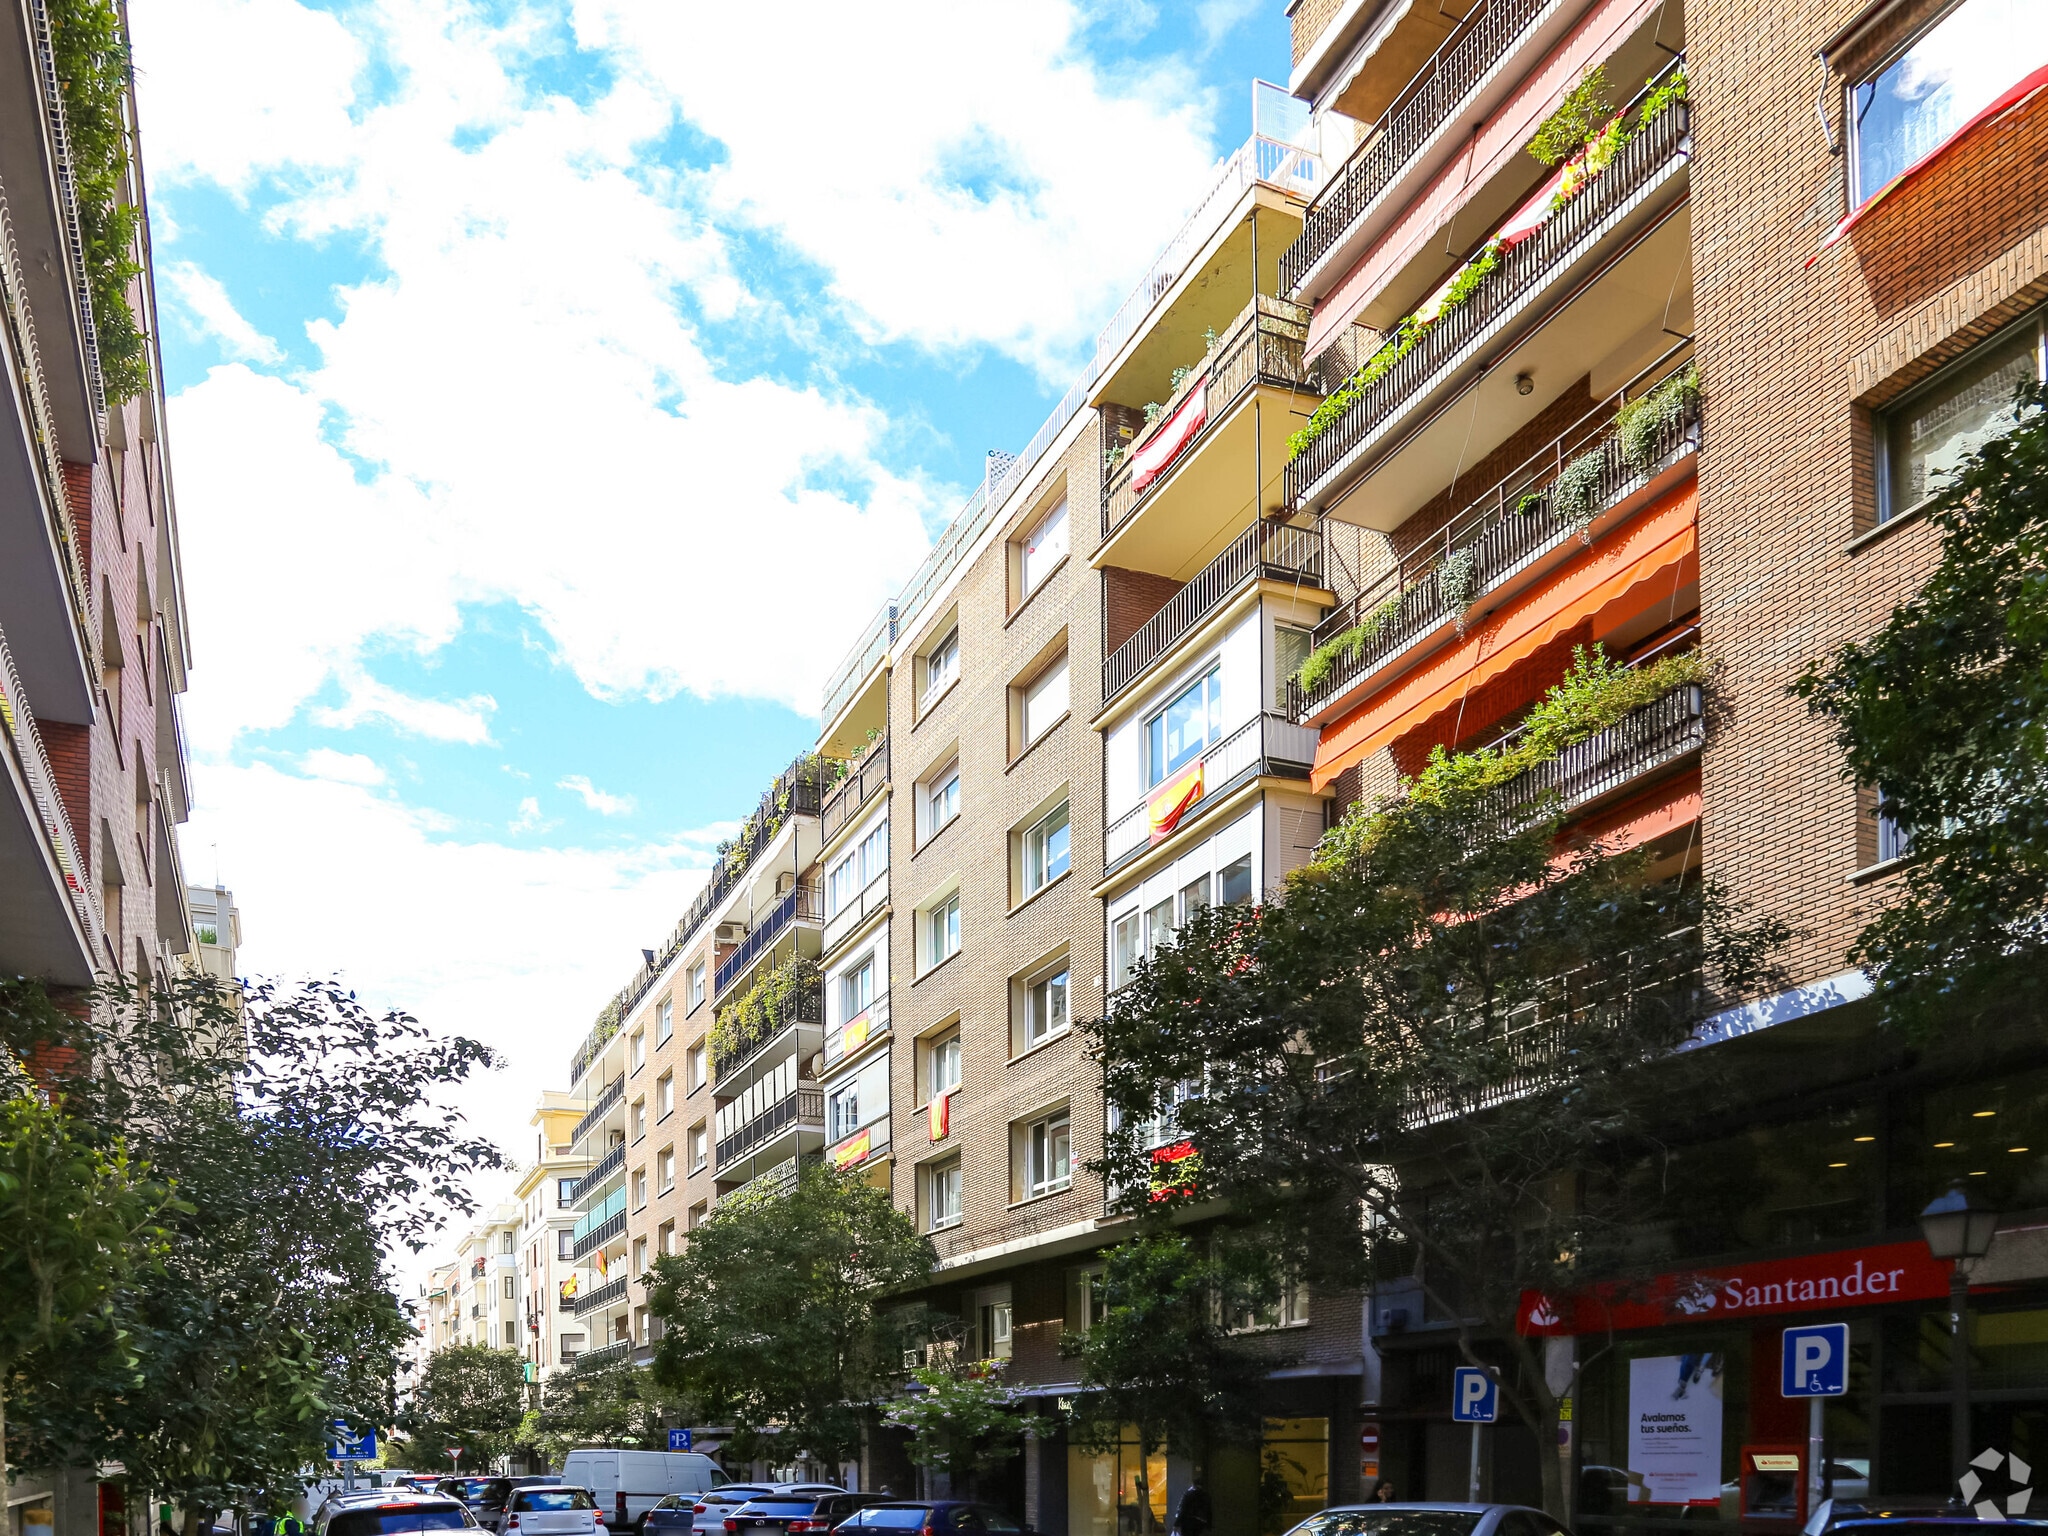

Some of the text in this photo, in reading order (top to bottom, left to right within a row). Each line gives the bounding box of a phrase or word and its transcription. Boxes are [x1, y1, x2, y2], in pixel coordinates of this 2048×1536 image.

[1724, 1259, 1904, 1309] Santander
[1794, 1335, 1831, 1389] P
[1461, 1374, 1488, 1415] P
[1641, 1413, 1686, 1422] Avalamos
[1641, 1422, 1692, 1433] tus sueños.
[674, 1432, 687, 1447] P
